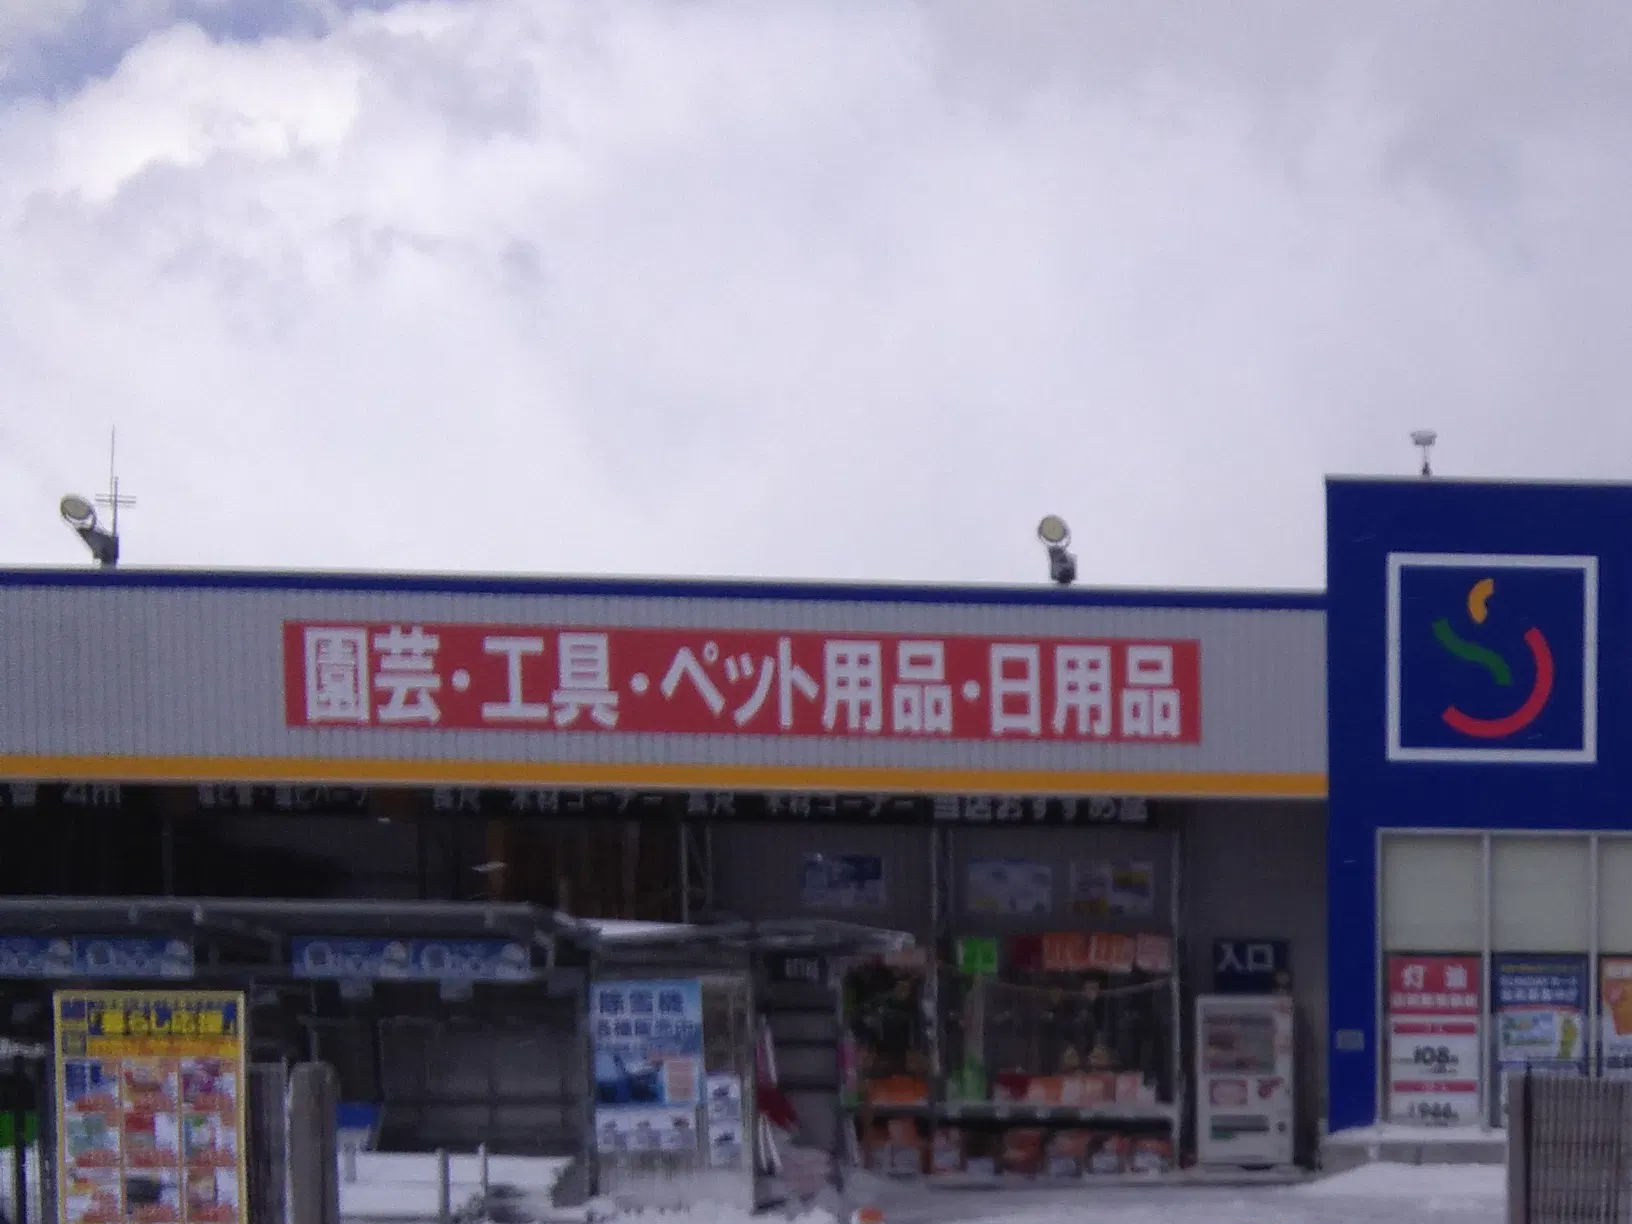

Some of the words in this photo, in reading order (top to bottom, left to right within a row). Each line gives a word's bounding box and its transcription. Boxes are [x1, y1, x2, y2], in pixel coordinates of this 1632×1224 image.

[304, 625, 1181, 738] 園芸・工具・ペット用品・日用品
[1217, 943, 1275, 973] 入口
